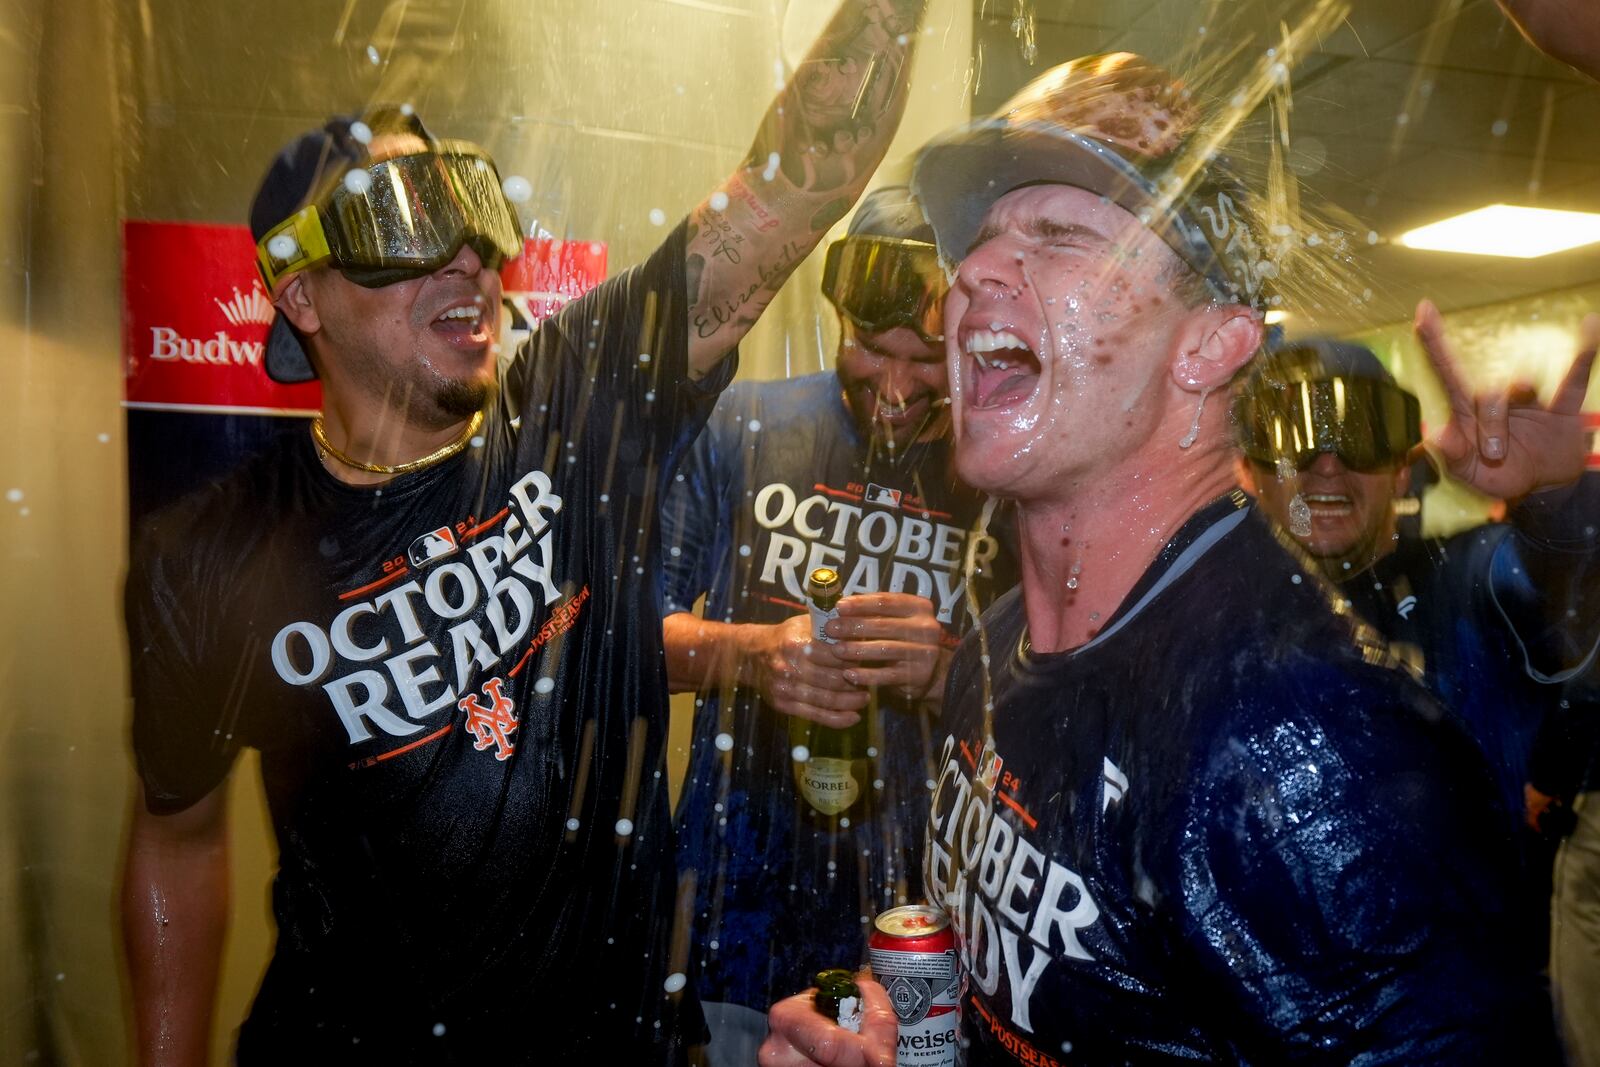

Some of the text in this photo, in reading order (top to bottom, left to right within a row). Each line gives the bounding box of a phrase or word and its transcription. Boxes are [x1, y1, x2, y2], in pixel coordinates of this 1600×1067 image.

[693, 239, 808, 339] Elizabeth
[754, 483, 999, 579] OCTOBER
[322, 529, 562, 745] READY
[804, 777, 850, 791] KORBEL
